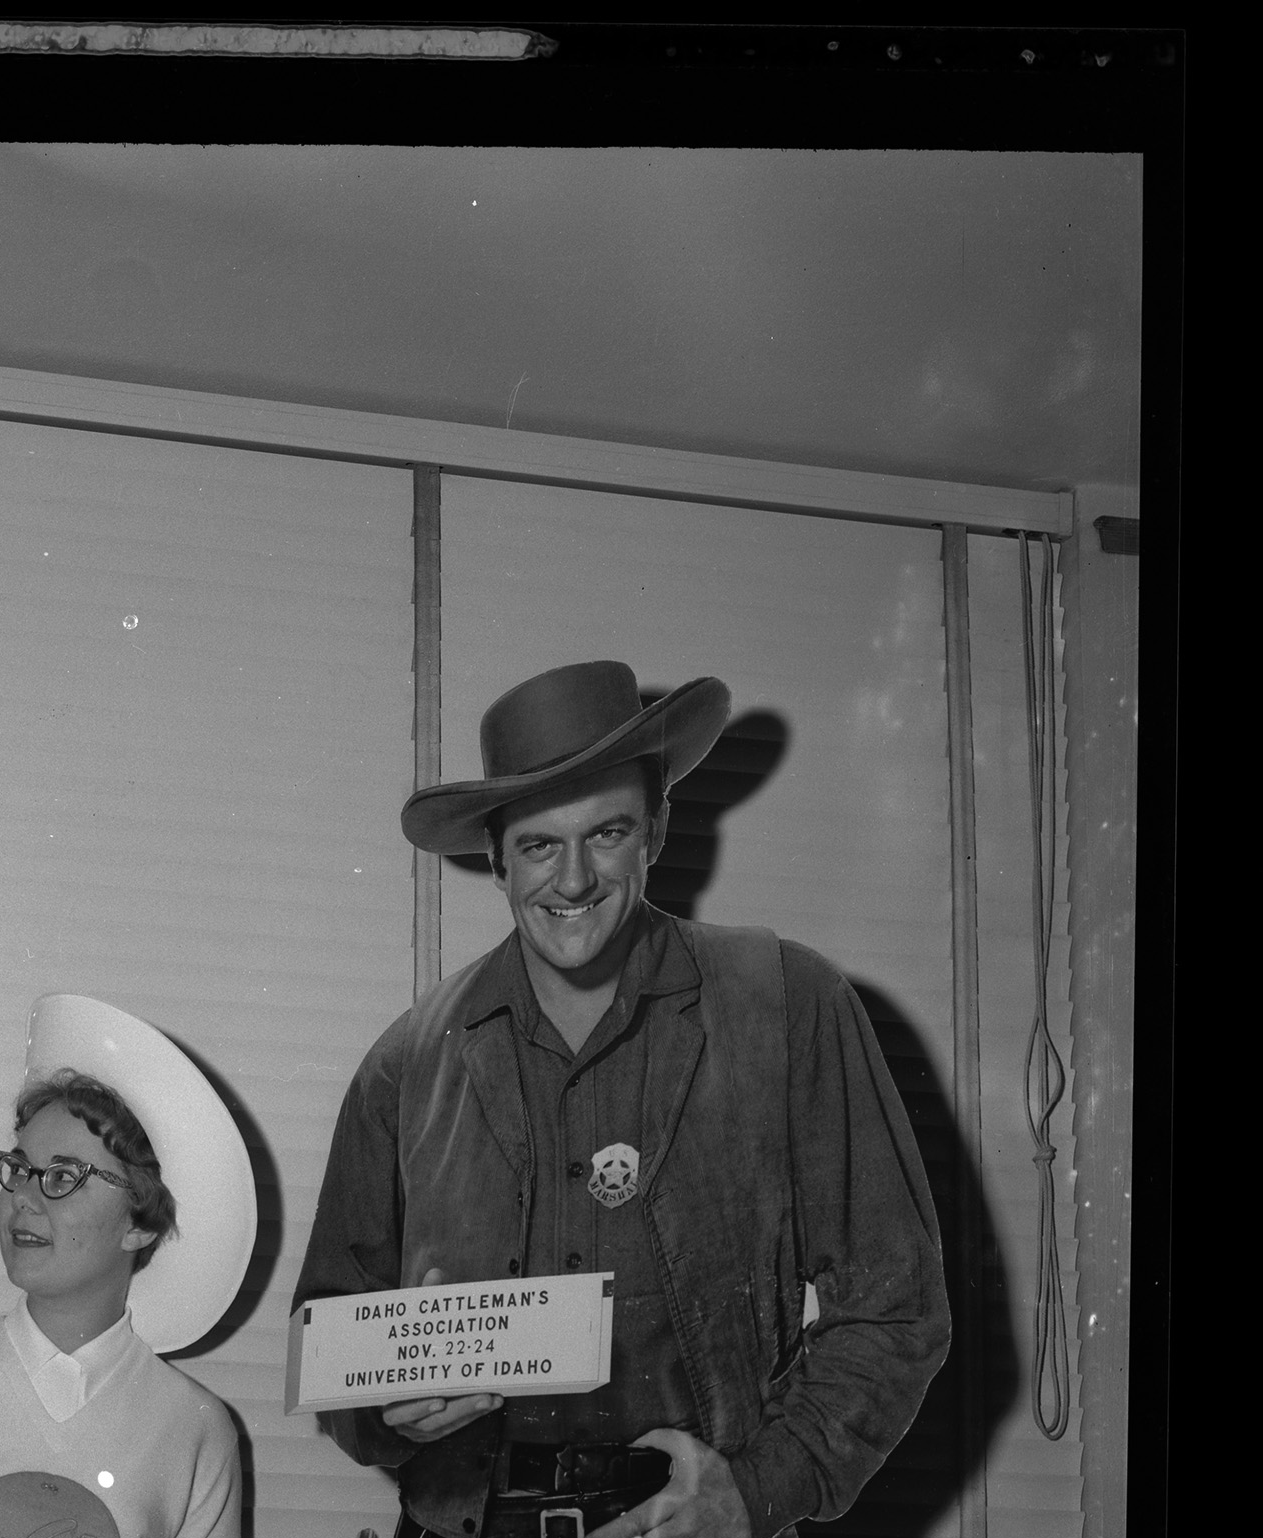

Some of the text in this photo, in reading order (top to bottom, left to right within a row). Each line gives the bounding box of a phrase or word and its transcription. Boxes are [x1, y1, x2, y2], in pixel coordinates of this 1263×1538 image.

[354, 1289, 550, 1322] IDAHO CATTLEMAN'S
[387, 1314, 510, 1340] ASSOCIATION
[396, 1343, 437, 1361] NOV.
[344, 1358, 553, 1387] UNIVERSITY OF IDAHO
